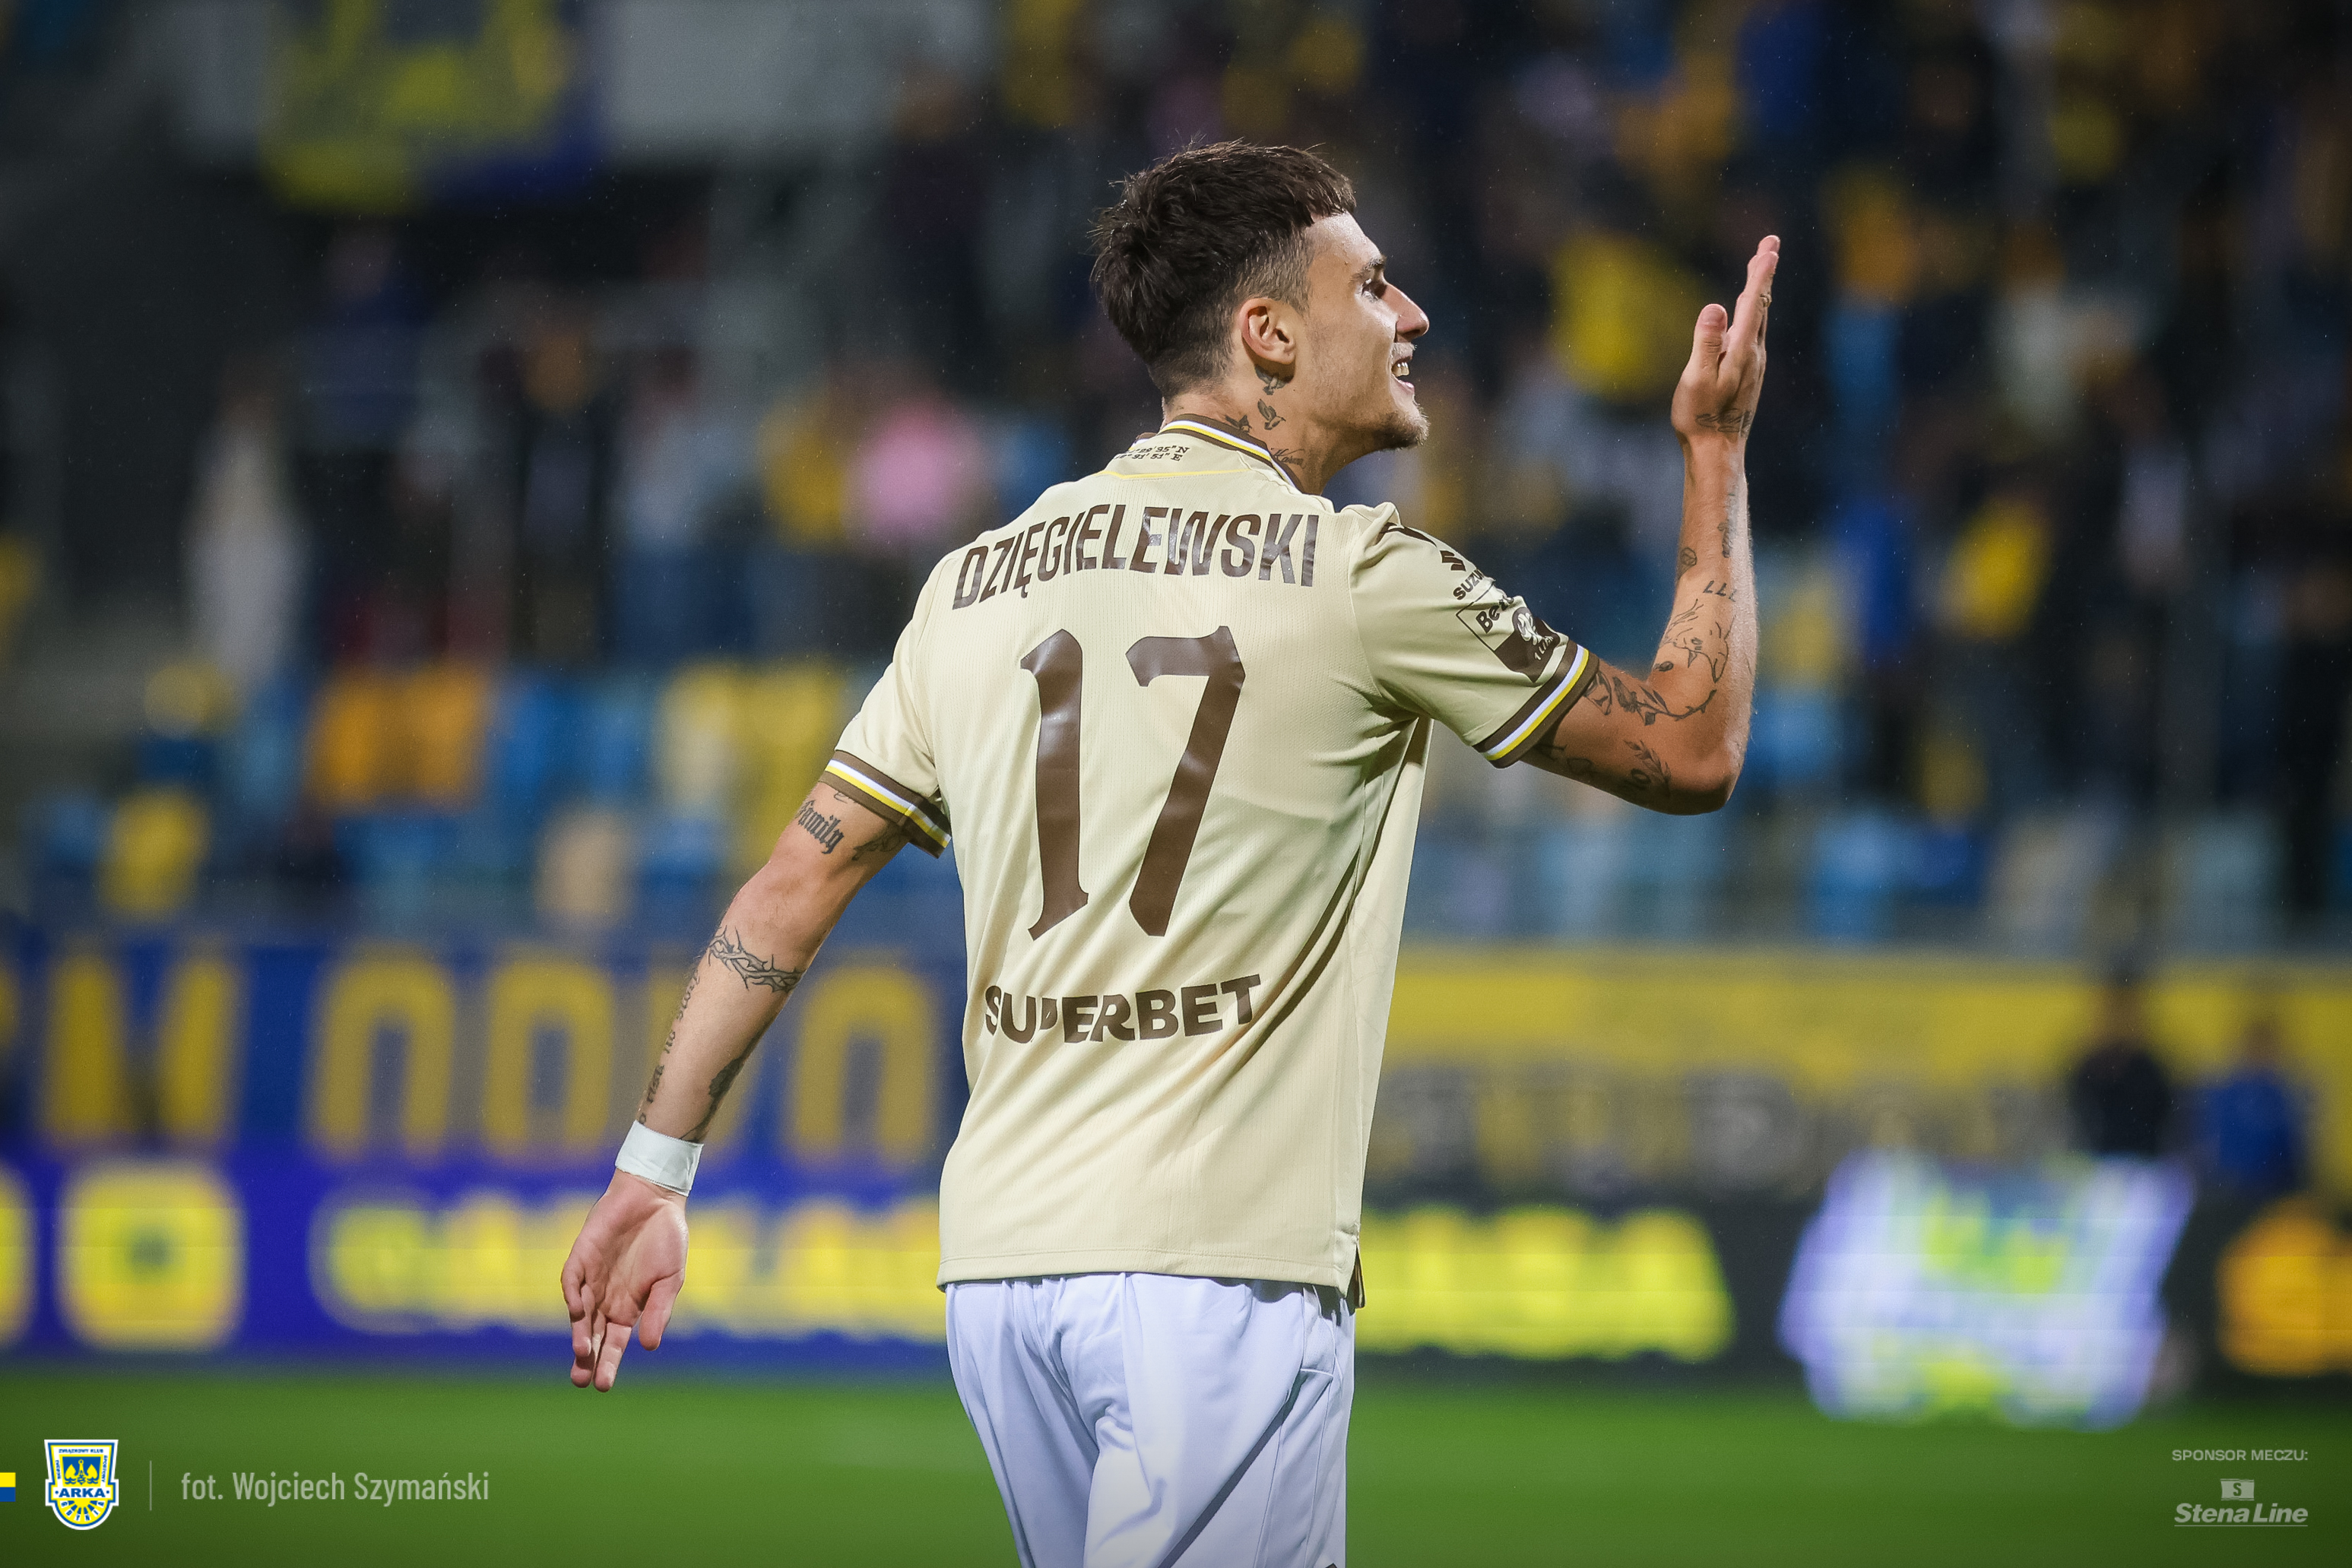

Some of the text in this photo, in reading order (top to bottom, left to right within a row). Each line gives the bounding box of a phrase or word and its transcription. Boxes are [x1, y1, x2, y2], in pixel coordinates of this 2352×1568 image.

[952, 504, 1319, 610] DZIĘGIELEWSKI
[1020, 626, 1246, 941] 17
[985, 974, 1261, 1044] SUPERBET
